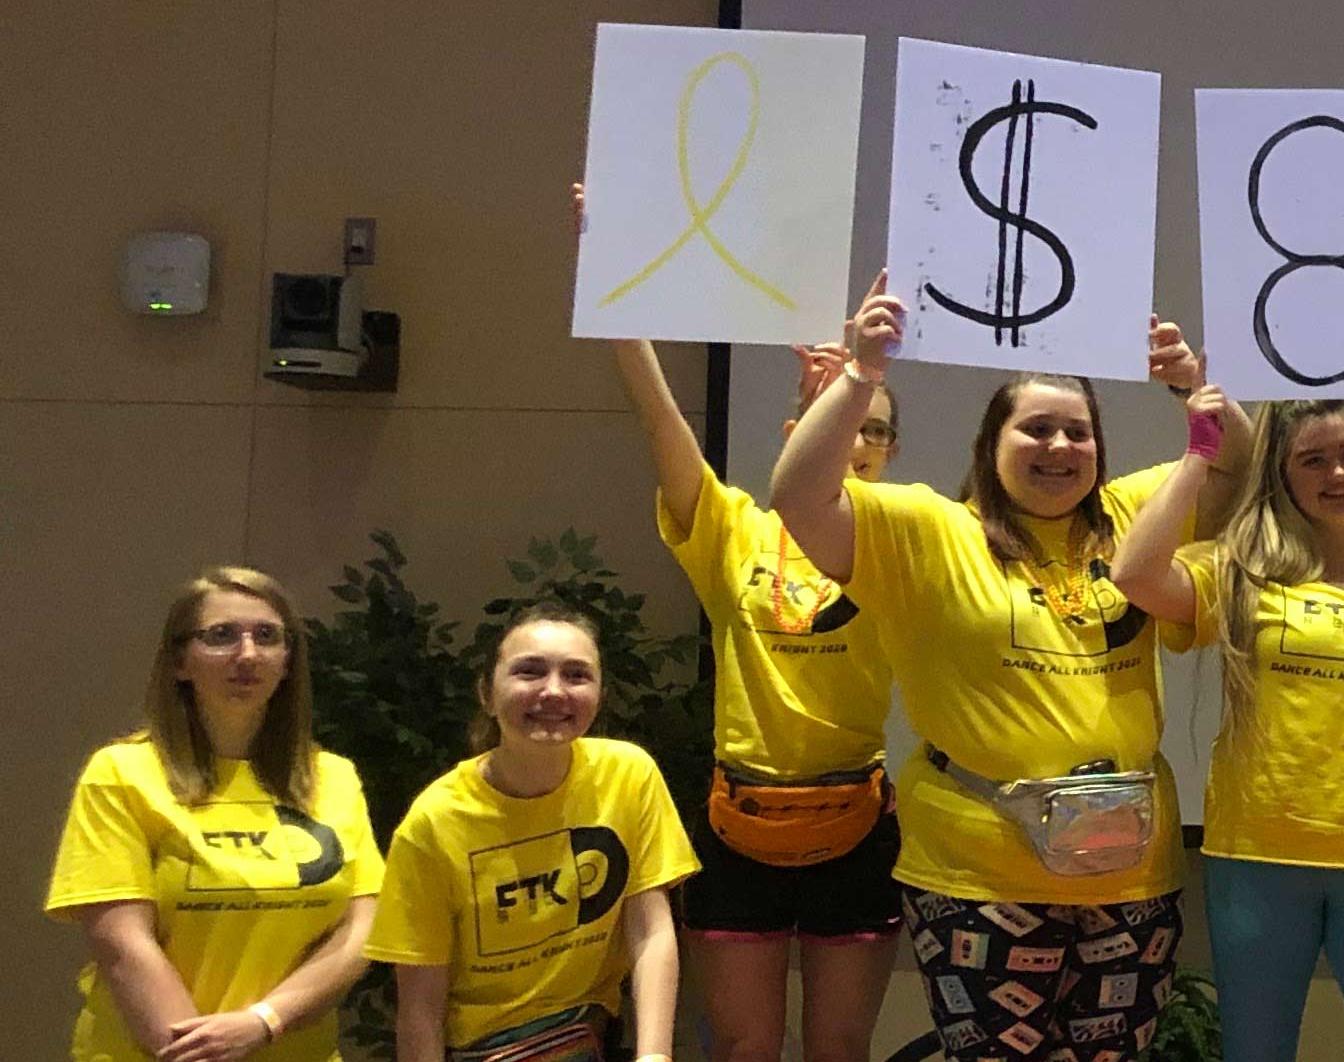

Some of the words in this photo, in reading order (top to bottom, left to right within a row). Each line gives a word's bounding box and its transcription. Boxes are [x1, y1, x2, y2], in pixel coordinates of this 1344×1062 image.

[924, 78, 1098, 348] $
[1001, 657, 1048, 673] DANCE
[1048, 663, 1071, 676] ALL
[1270, 662, 1312, 676] DANCE
[1312, 668, 1336, 680] ALL
[495, 868, 569, 924] FTK
